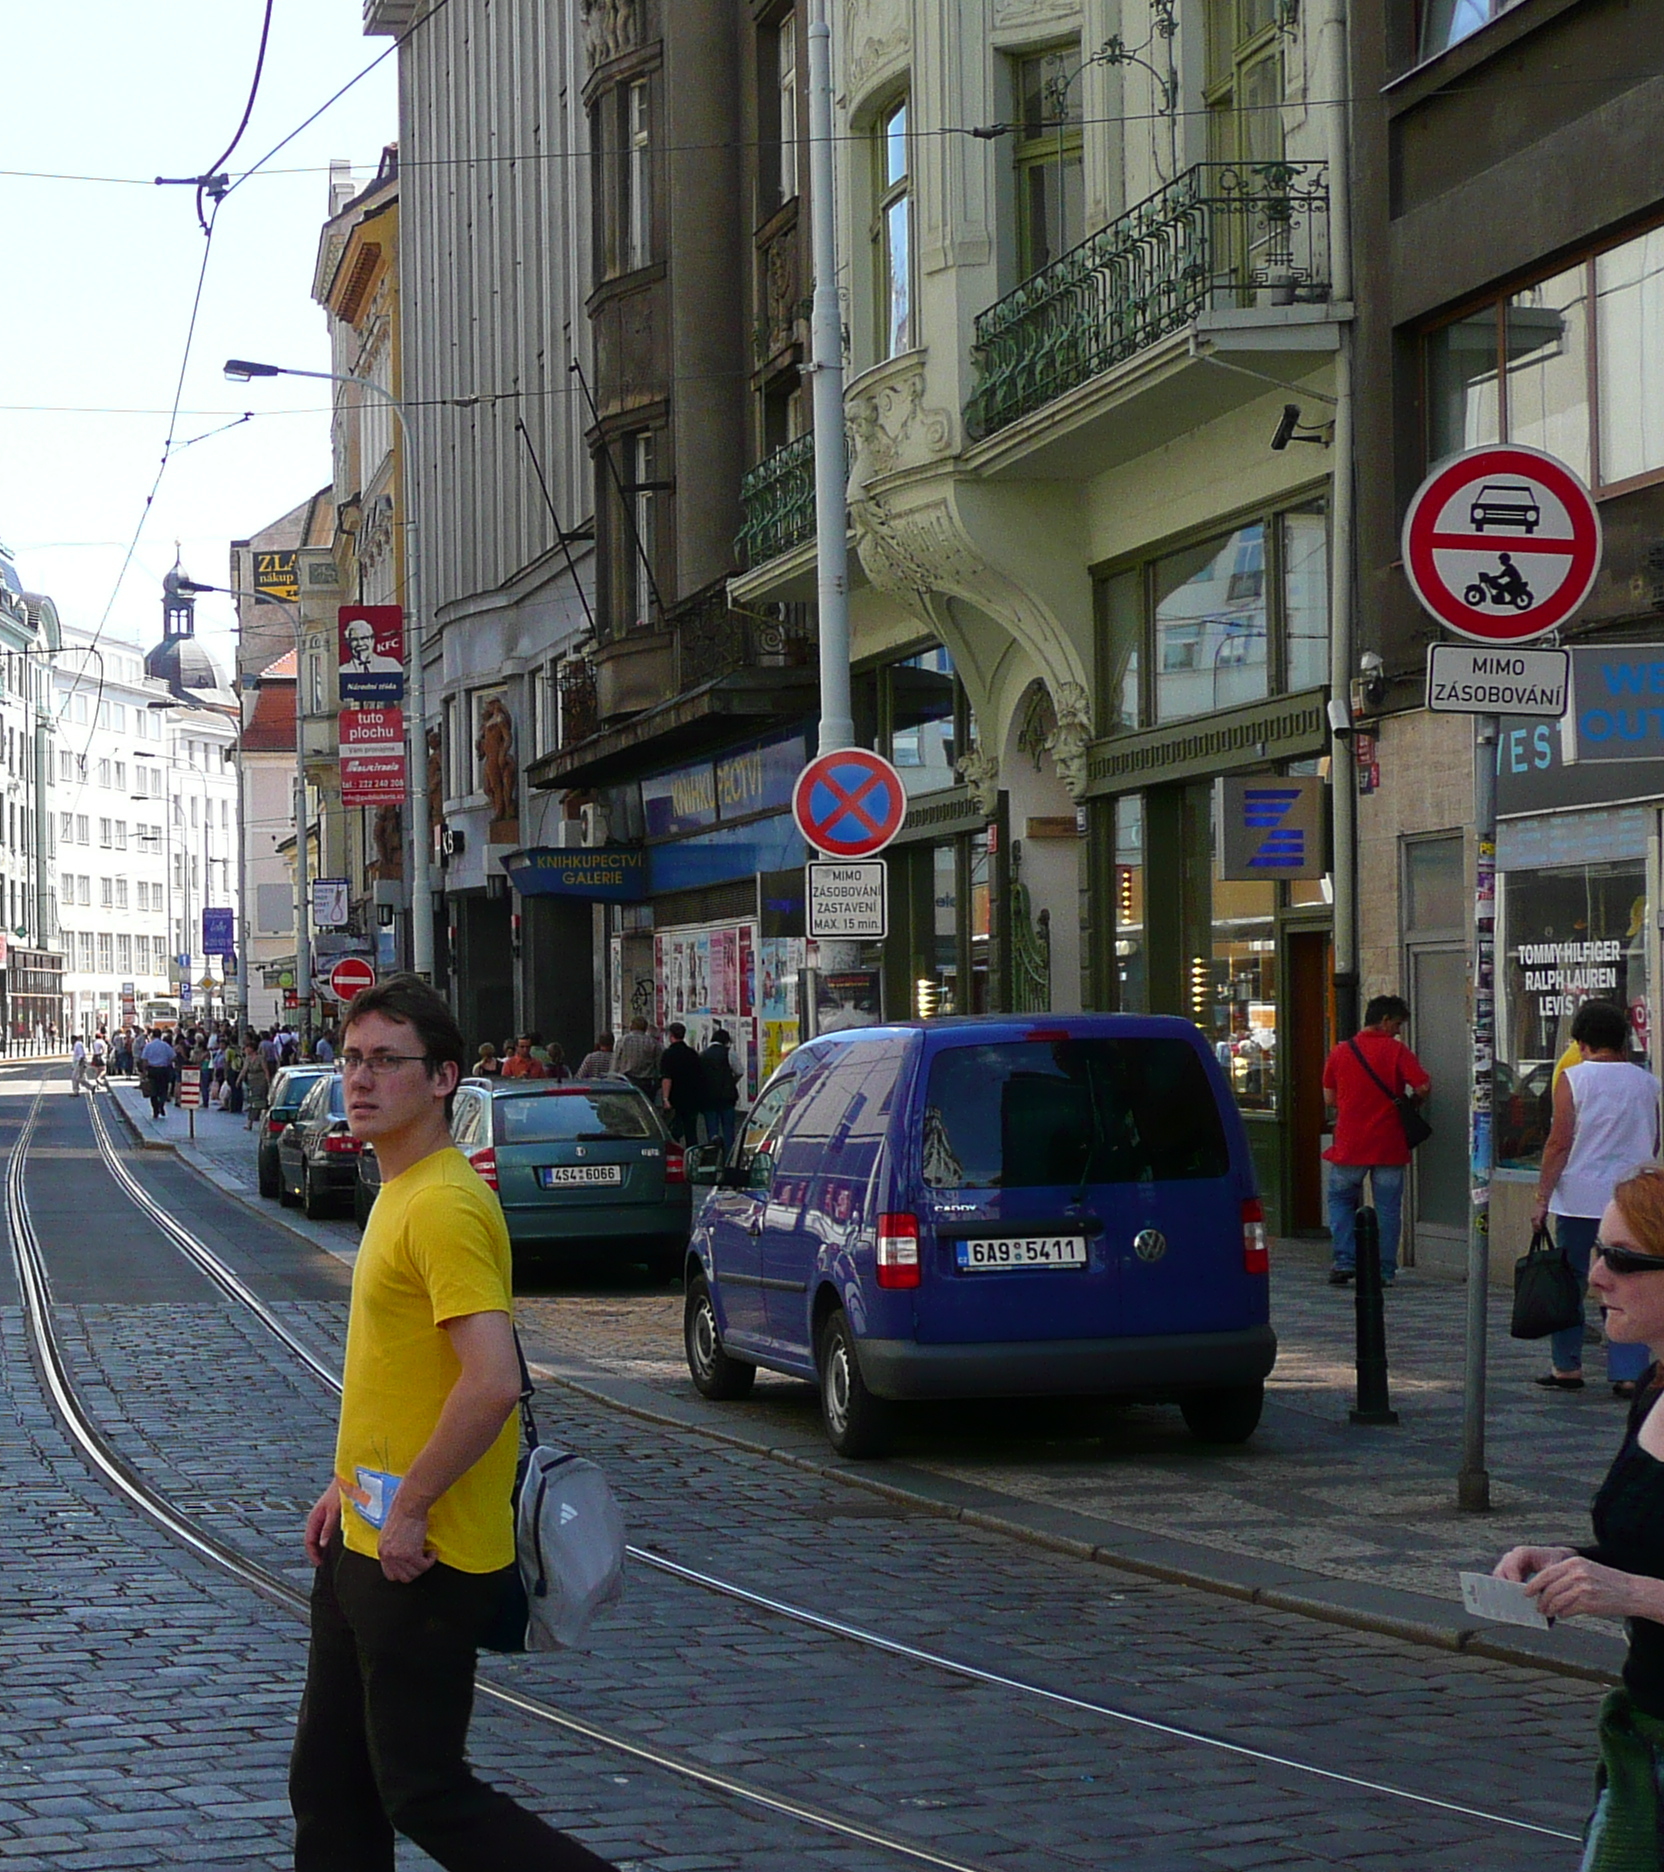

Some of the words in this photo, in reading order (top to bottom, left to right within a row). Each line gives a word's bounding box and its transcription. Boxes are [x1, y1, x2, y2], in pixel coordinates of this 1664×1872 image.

[259, 573, 294, 584] nákup
[377, 638, 400, 653] KFC
[1472, 657, 1525, 676] MIMO
[1434, 681, 1563, 706] ZÁSOBOVÁNÍ
[358, 712, 384, 724] tuto
[349, 726, 394, 742] plochu
[442, 829, 454, 855] KB
[537, 851, 643, 869] KNIHKUPECTVÍ
[562, 871, 624, 885] GALERIE
[832, 871, 862, 881] MIMO
[812, 884, 882, 898] ZÁSOBOVÁNÍ
[817, 900, 877, 914] ZASTAVENÍ
[814, 918, 840, 930] MAX.
[844, 918, 855, 929] 15
[857, 917, 881, 929] min.
[1518, 943, 1563, 965] TOMMY
[1564, 940, 1621, 963] HILFIGER
[1525, 970, 1565, 991] RALPH
[1567, 967, 1617, 990] LAUREN
[555, 1169, 576, 1181] 4S4
[586, 1167, 615, 1180] 6066
[972, 1242, 1010, 1263] 6A9
[1026, 1239, 1076, 1261] 5411
